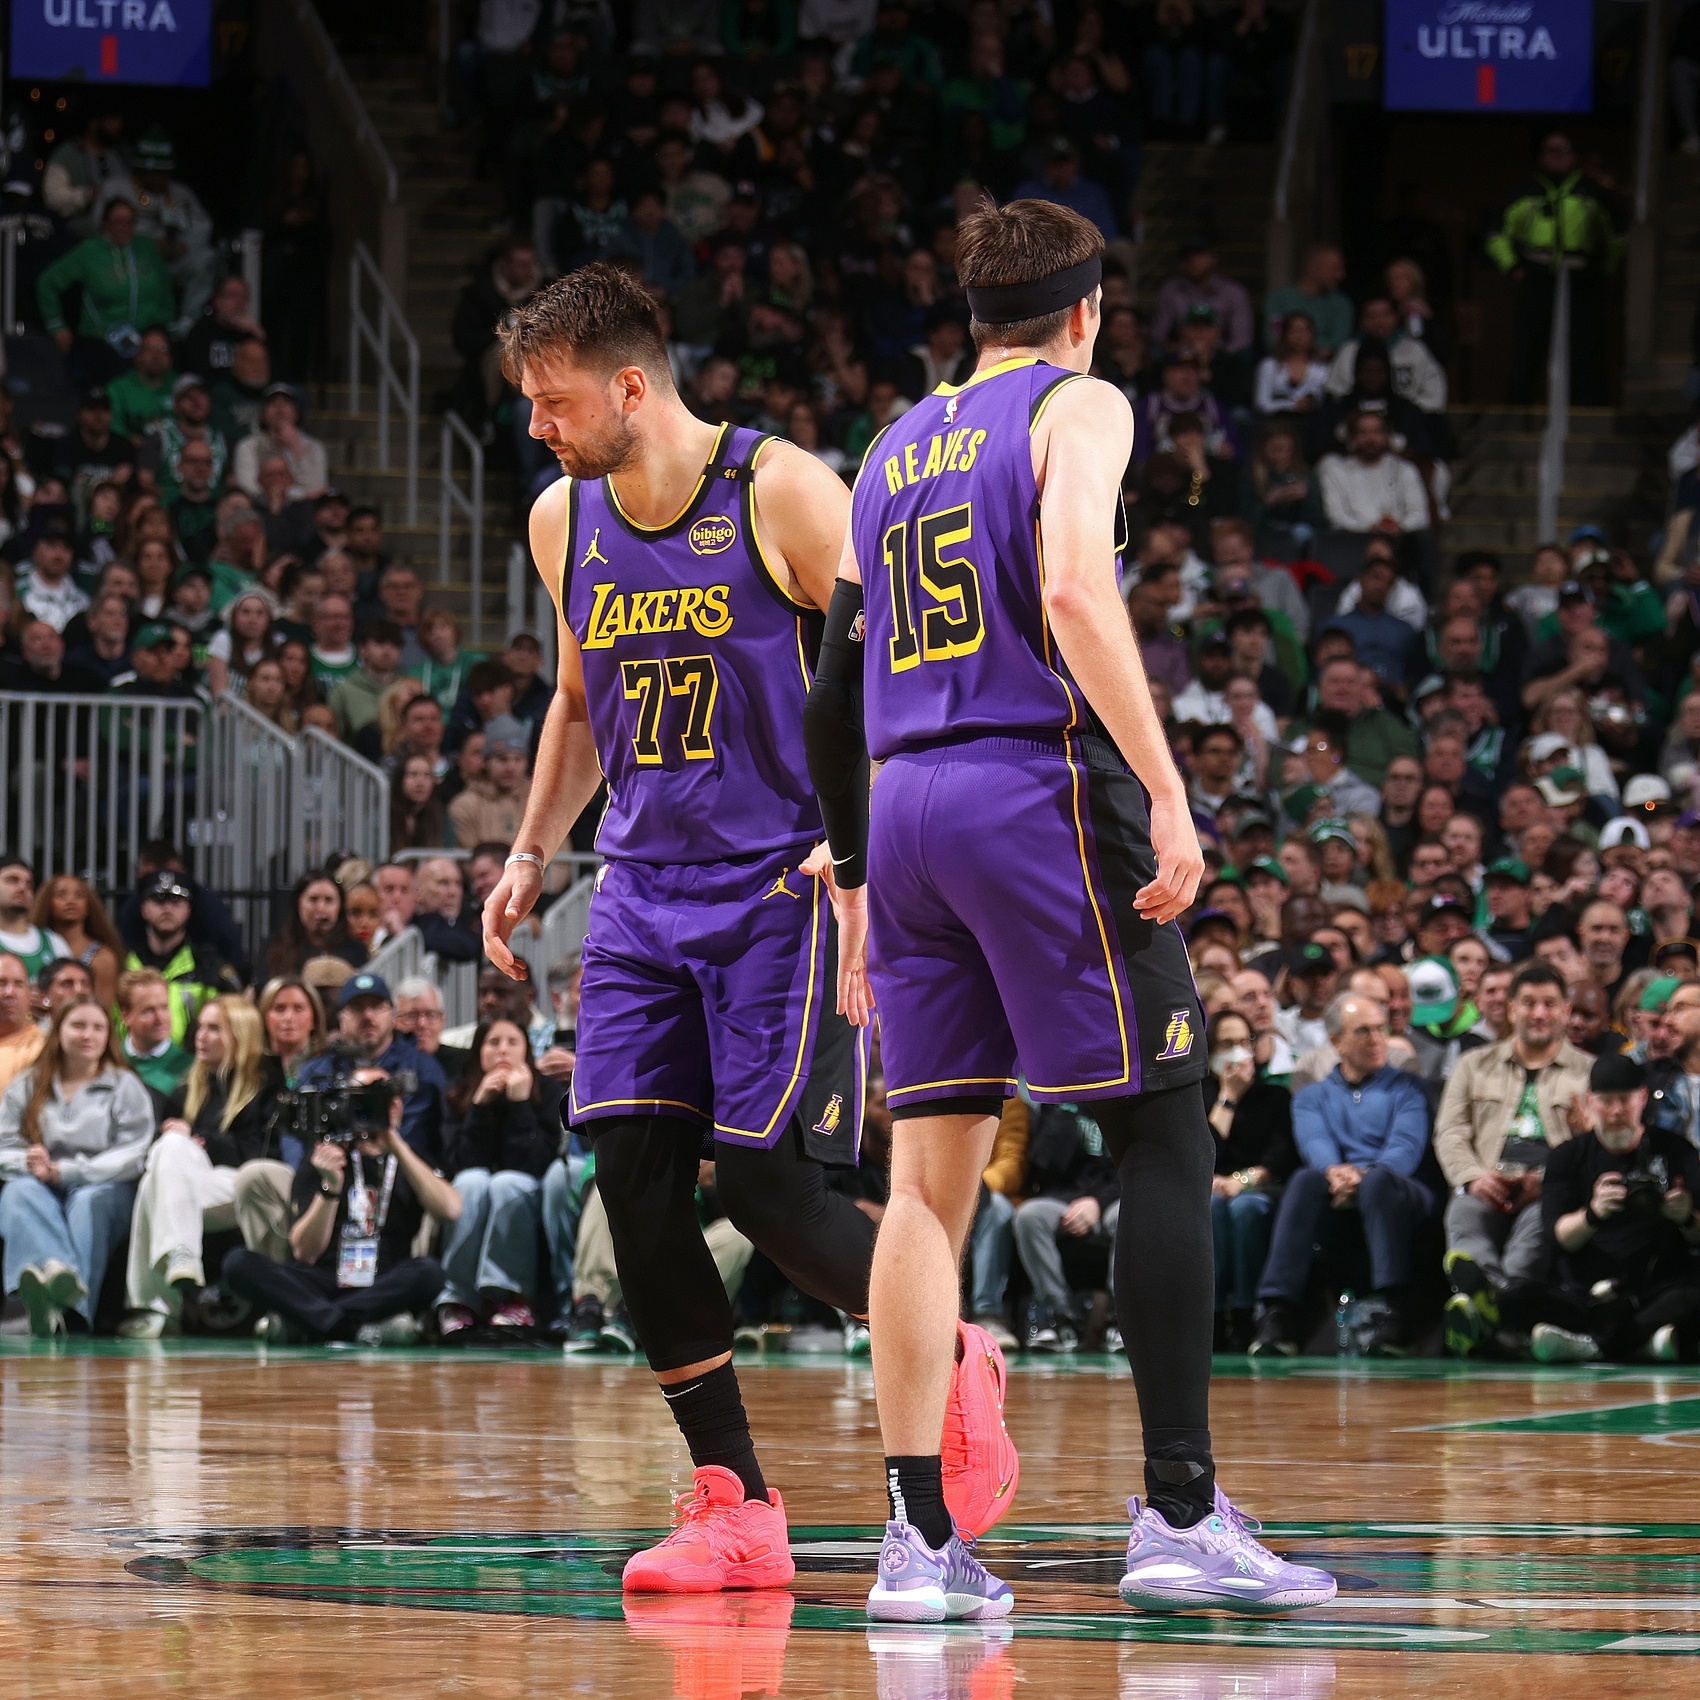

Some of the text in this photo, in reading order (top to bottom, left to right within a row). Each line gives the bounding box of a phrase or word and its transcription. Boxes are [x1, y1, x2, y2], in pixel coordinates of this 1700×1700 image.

[43, 0, 177, 32] ULTRA
[1417, 24, 1558, 60] ULTRA
[724, 468, 738, 479] 44
[884, 428, 988, 497] REAVES
[693, 526, 733, 542] bibigo
[883, 501, 986, 674] 15
[581, 582, 735, 650] LAKERS
[620, 654, 720, 765] 77
